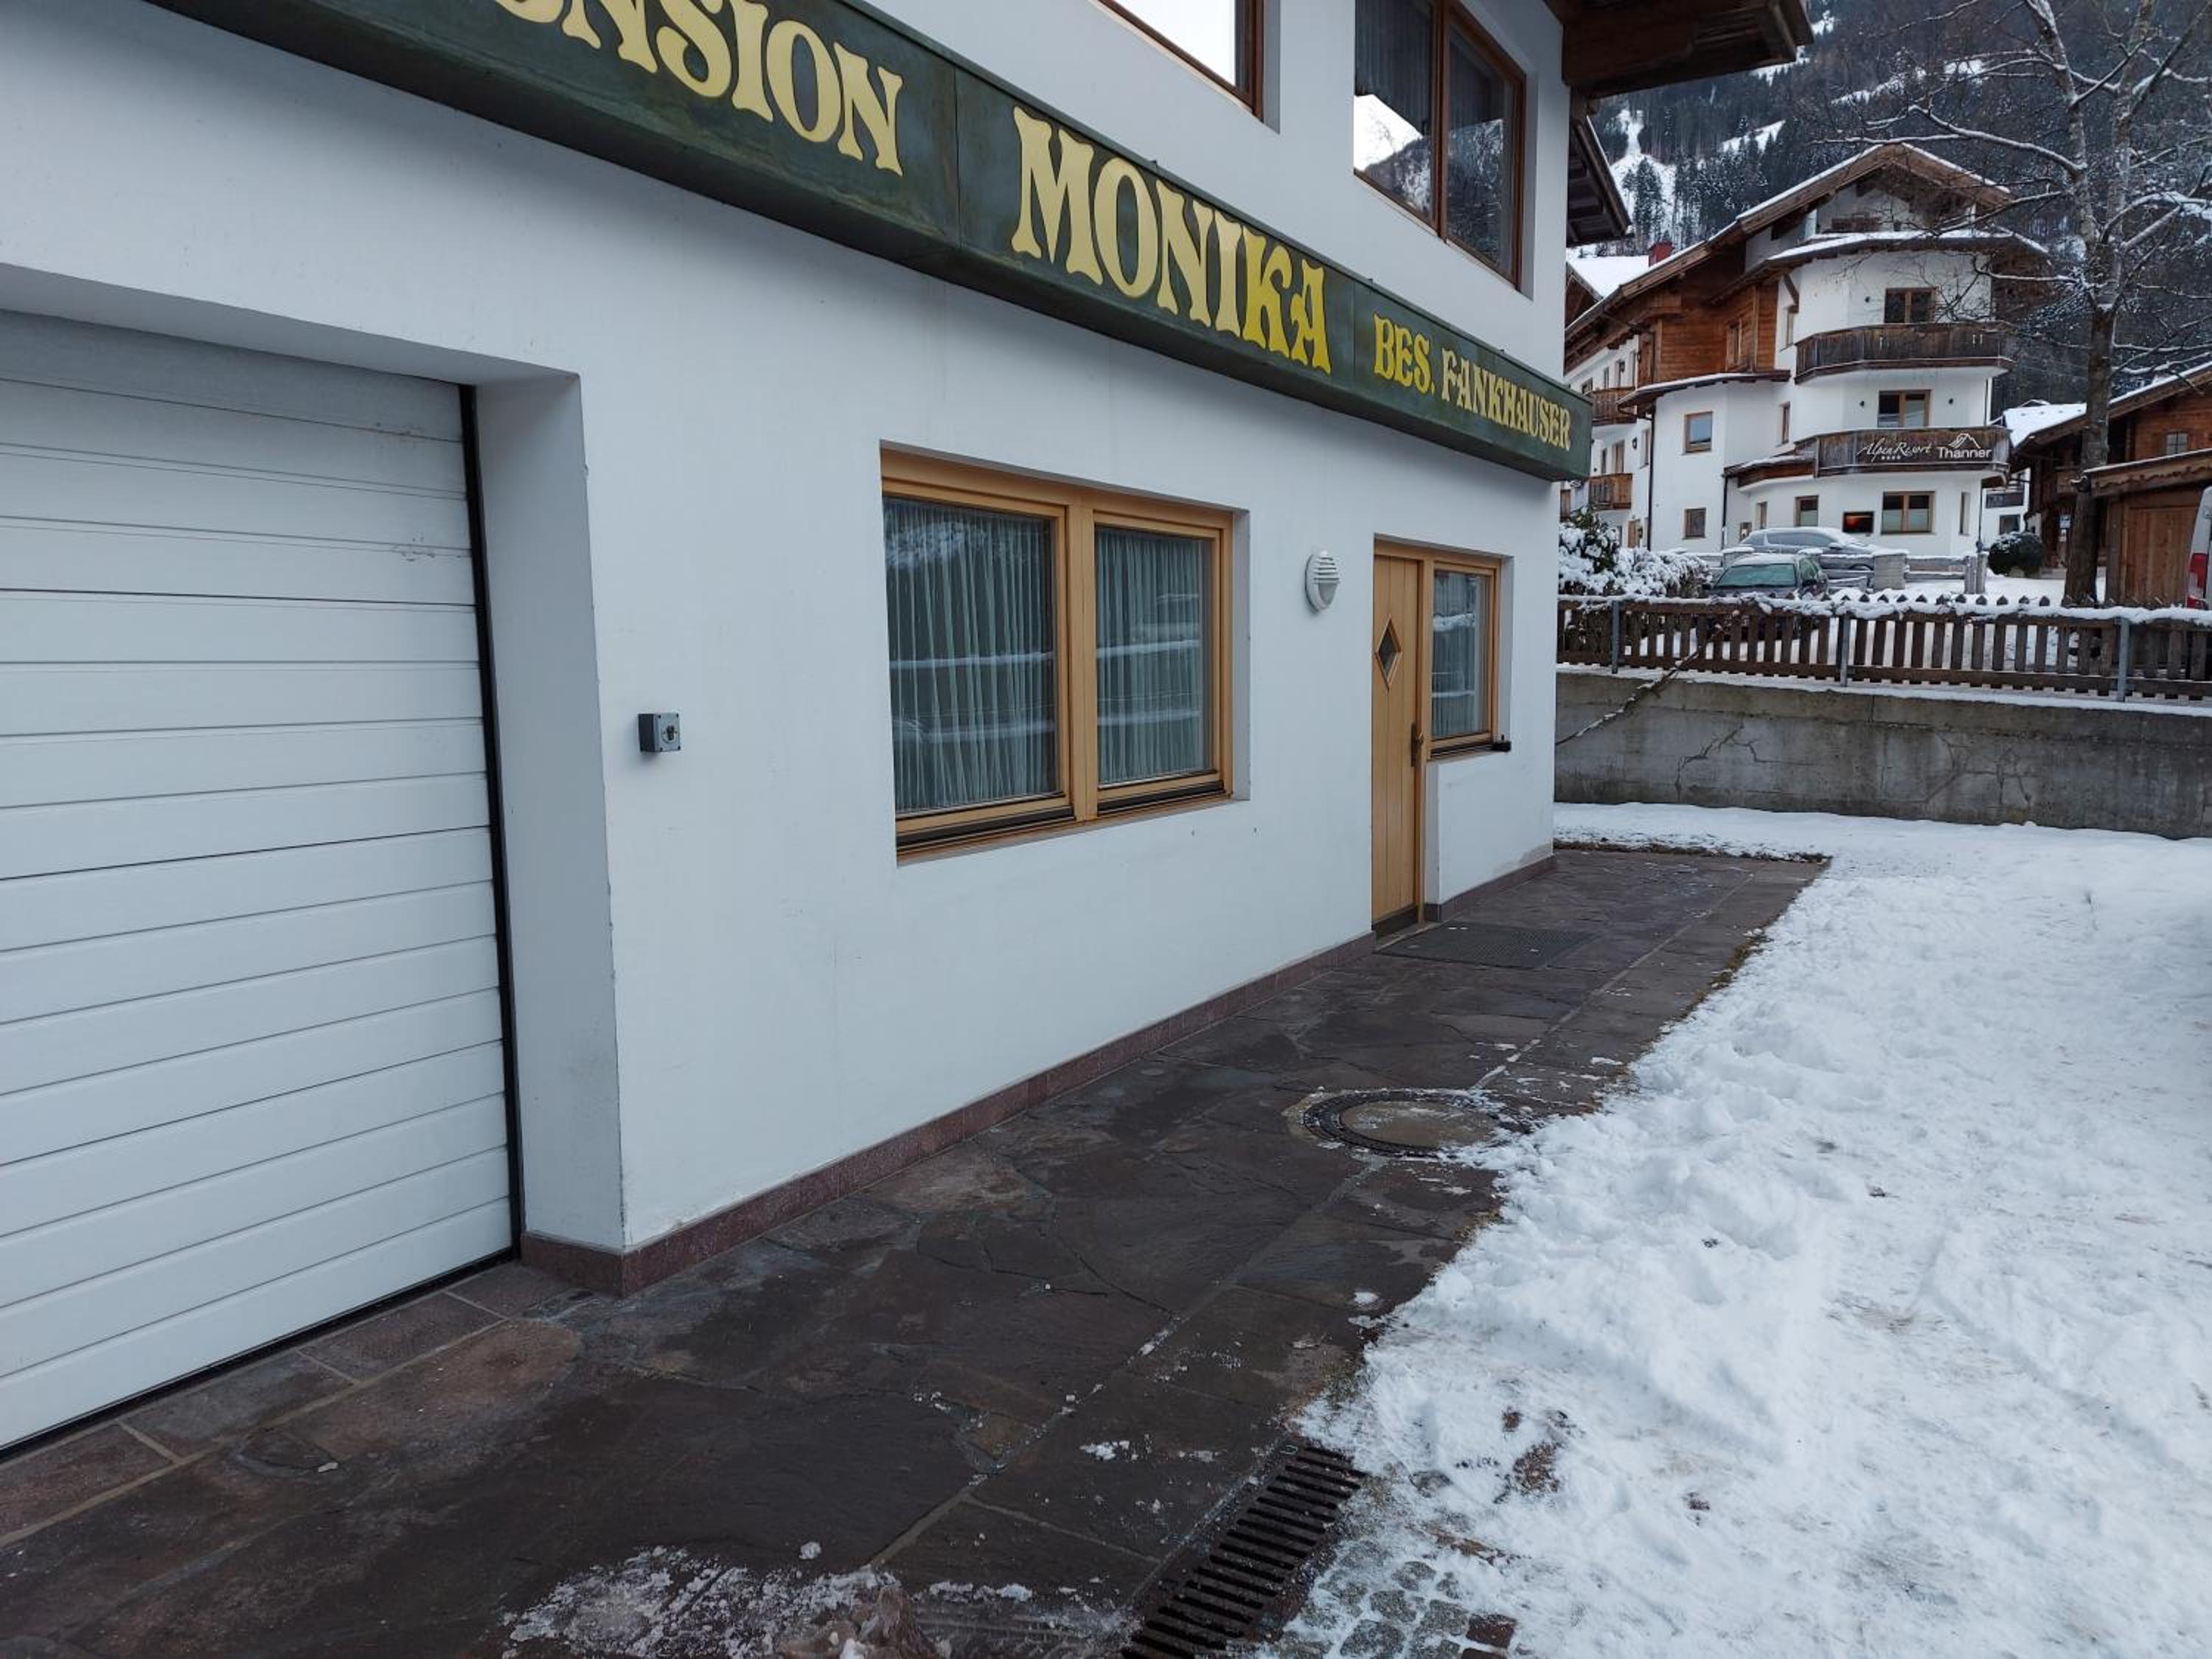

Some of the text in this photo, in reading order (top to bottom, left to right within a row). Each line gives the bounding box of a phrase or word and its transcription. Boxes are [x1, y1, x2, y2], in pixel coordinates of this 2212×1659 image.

[495, 0, 1571, 451] SION MONIKA BES. FANKHAUSER
[1935, 446, 1992, 459] Thanner
